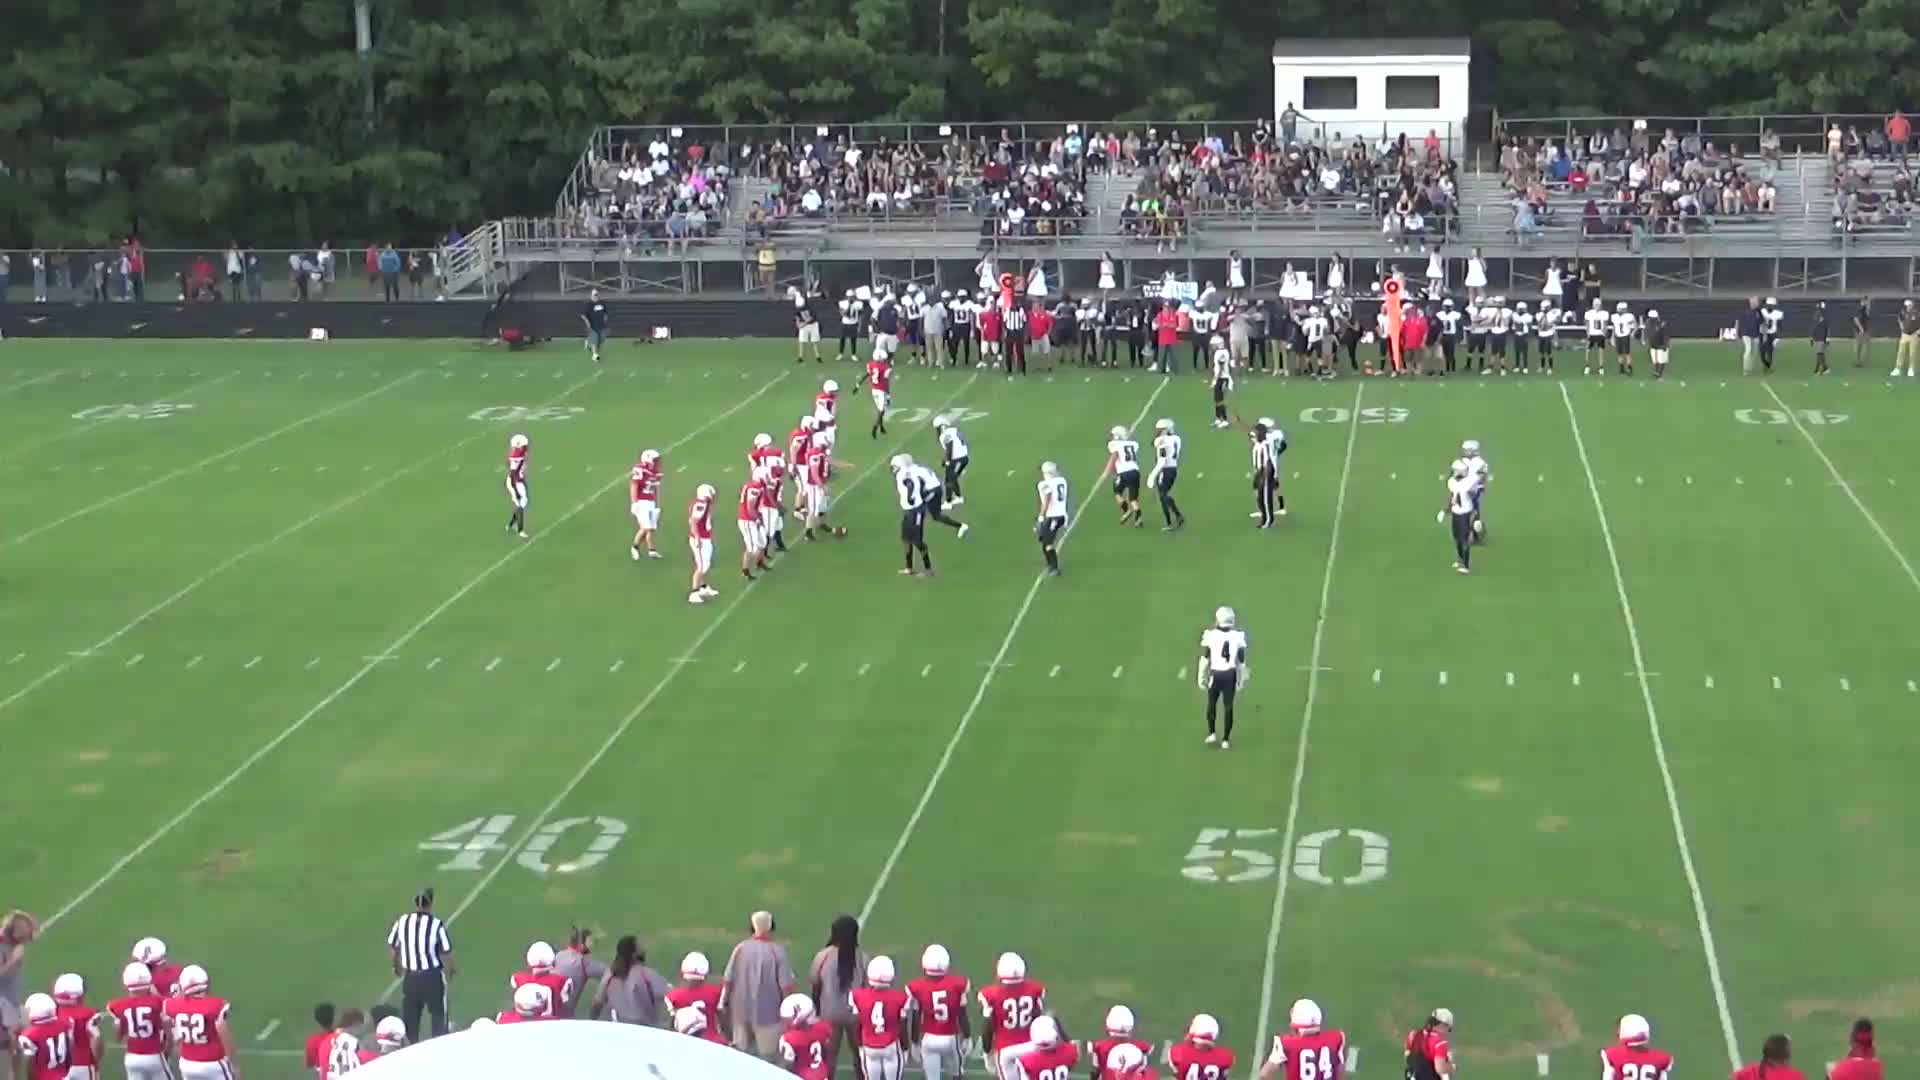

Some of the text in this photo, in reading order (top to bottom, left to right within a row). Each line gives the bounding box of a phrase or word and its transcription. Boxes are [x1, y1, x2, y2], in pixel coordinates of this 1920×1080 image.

[1299, 407, 1410, 424] 50
[1734, 408, 1849, 424] 40
[902, 478, 916, 506] 2
[1221, 640, 1231, 663] 4
[417, 814, 628, 873] 40
[1180, 828, 1390, 884] 50
[124, 1006, 153, 1038] 15
[870, 1001, 886, 1034] 4
[931, 990, 949, 1022] 5
[1002, 995, 1033, 1029] 32
[175, 1013, 209, 1044] 62
[809, 1040, 823, 1070] 3
[1299, 1046, 1333, 1080] 64
